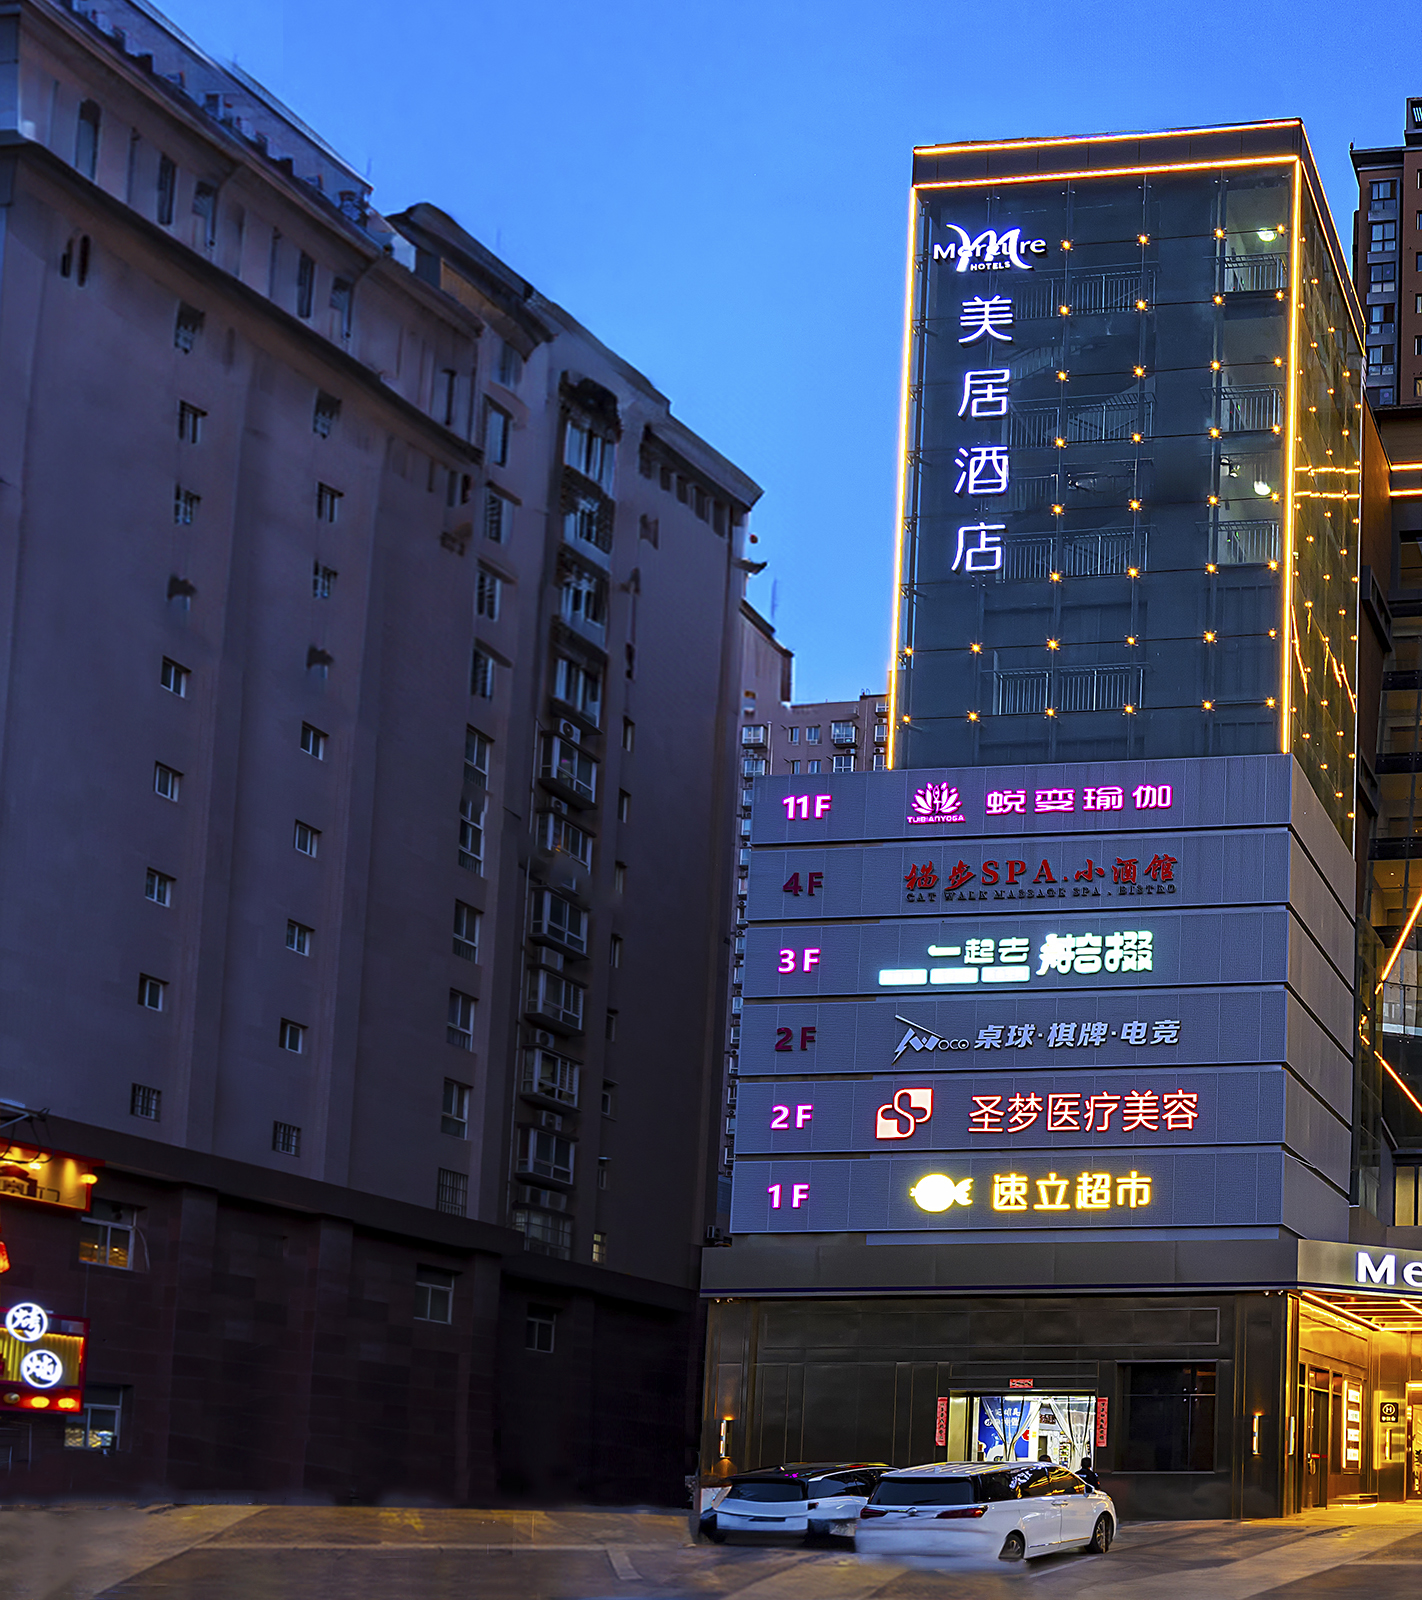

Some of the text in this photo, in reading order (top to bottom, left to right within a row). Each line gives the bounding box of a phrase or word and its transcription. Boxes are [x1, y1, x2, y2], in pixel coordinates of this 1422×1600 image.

[970, 261, 1011, 271] HOTELS
[952, 294, 1013, 573] 美居酒店
[783, 795, 832, 819] 11F
[986, 785, 1173, 814] 蜕变瑜伽
[782, 871, 824, 895] 4F
[906, 883, 1176, 902] CAT WALK MASSAGE SPA BISTRO
[778, 948, 821, 972] 3F
[927, 937, 1030, 965] 一起去
[774, 1026, 816, 1051] 2F
[770, 1105, 813, 1129] 2F
[968, 1089, 1198, 1132] 圣梦医疗美容
[767, 1184, 810, 1208] 1F
[993, 1171, 1152, 1211] 速立超市
